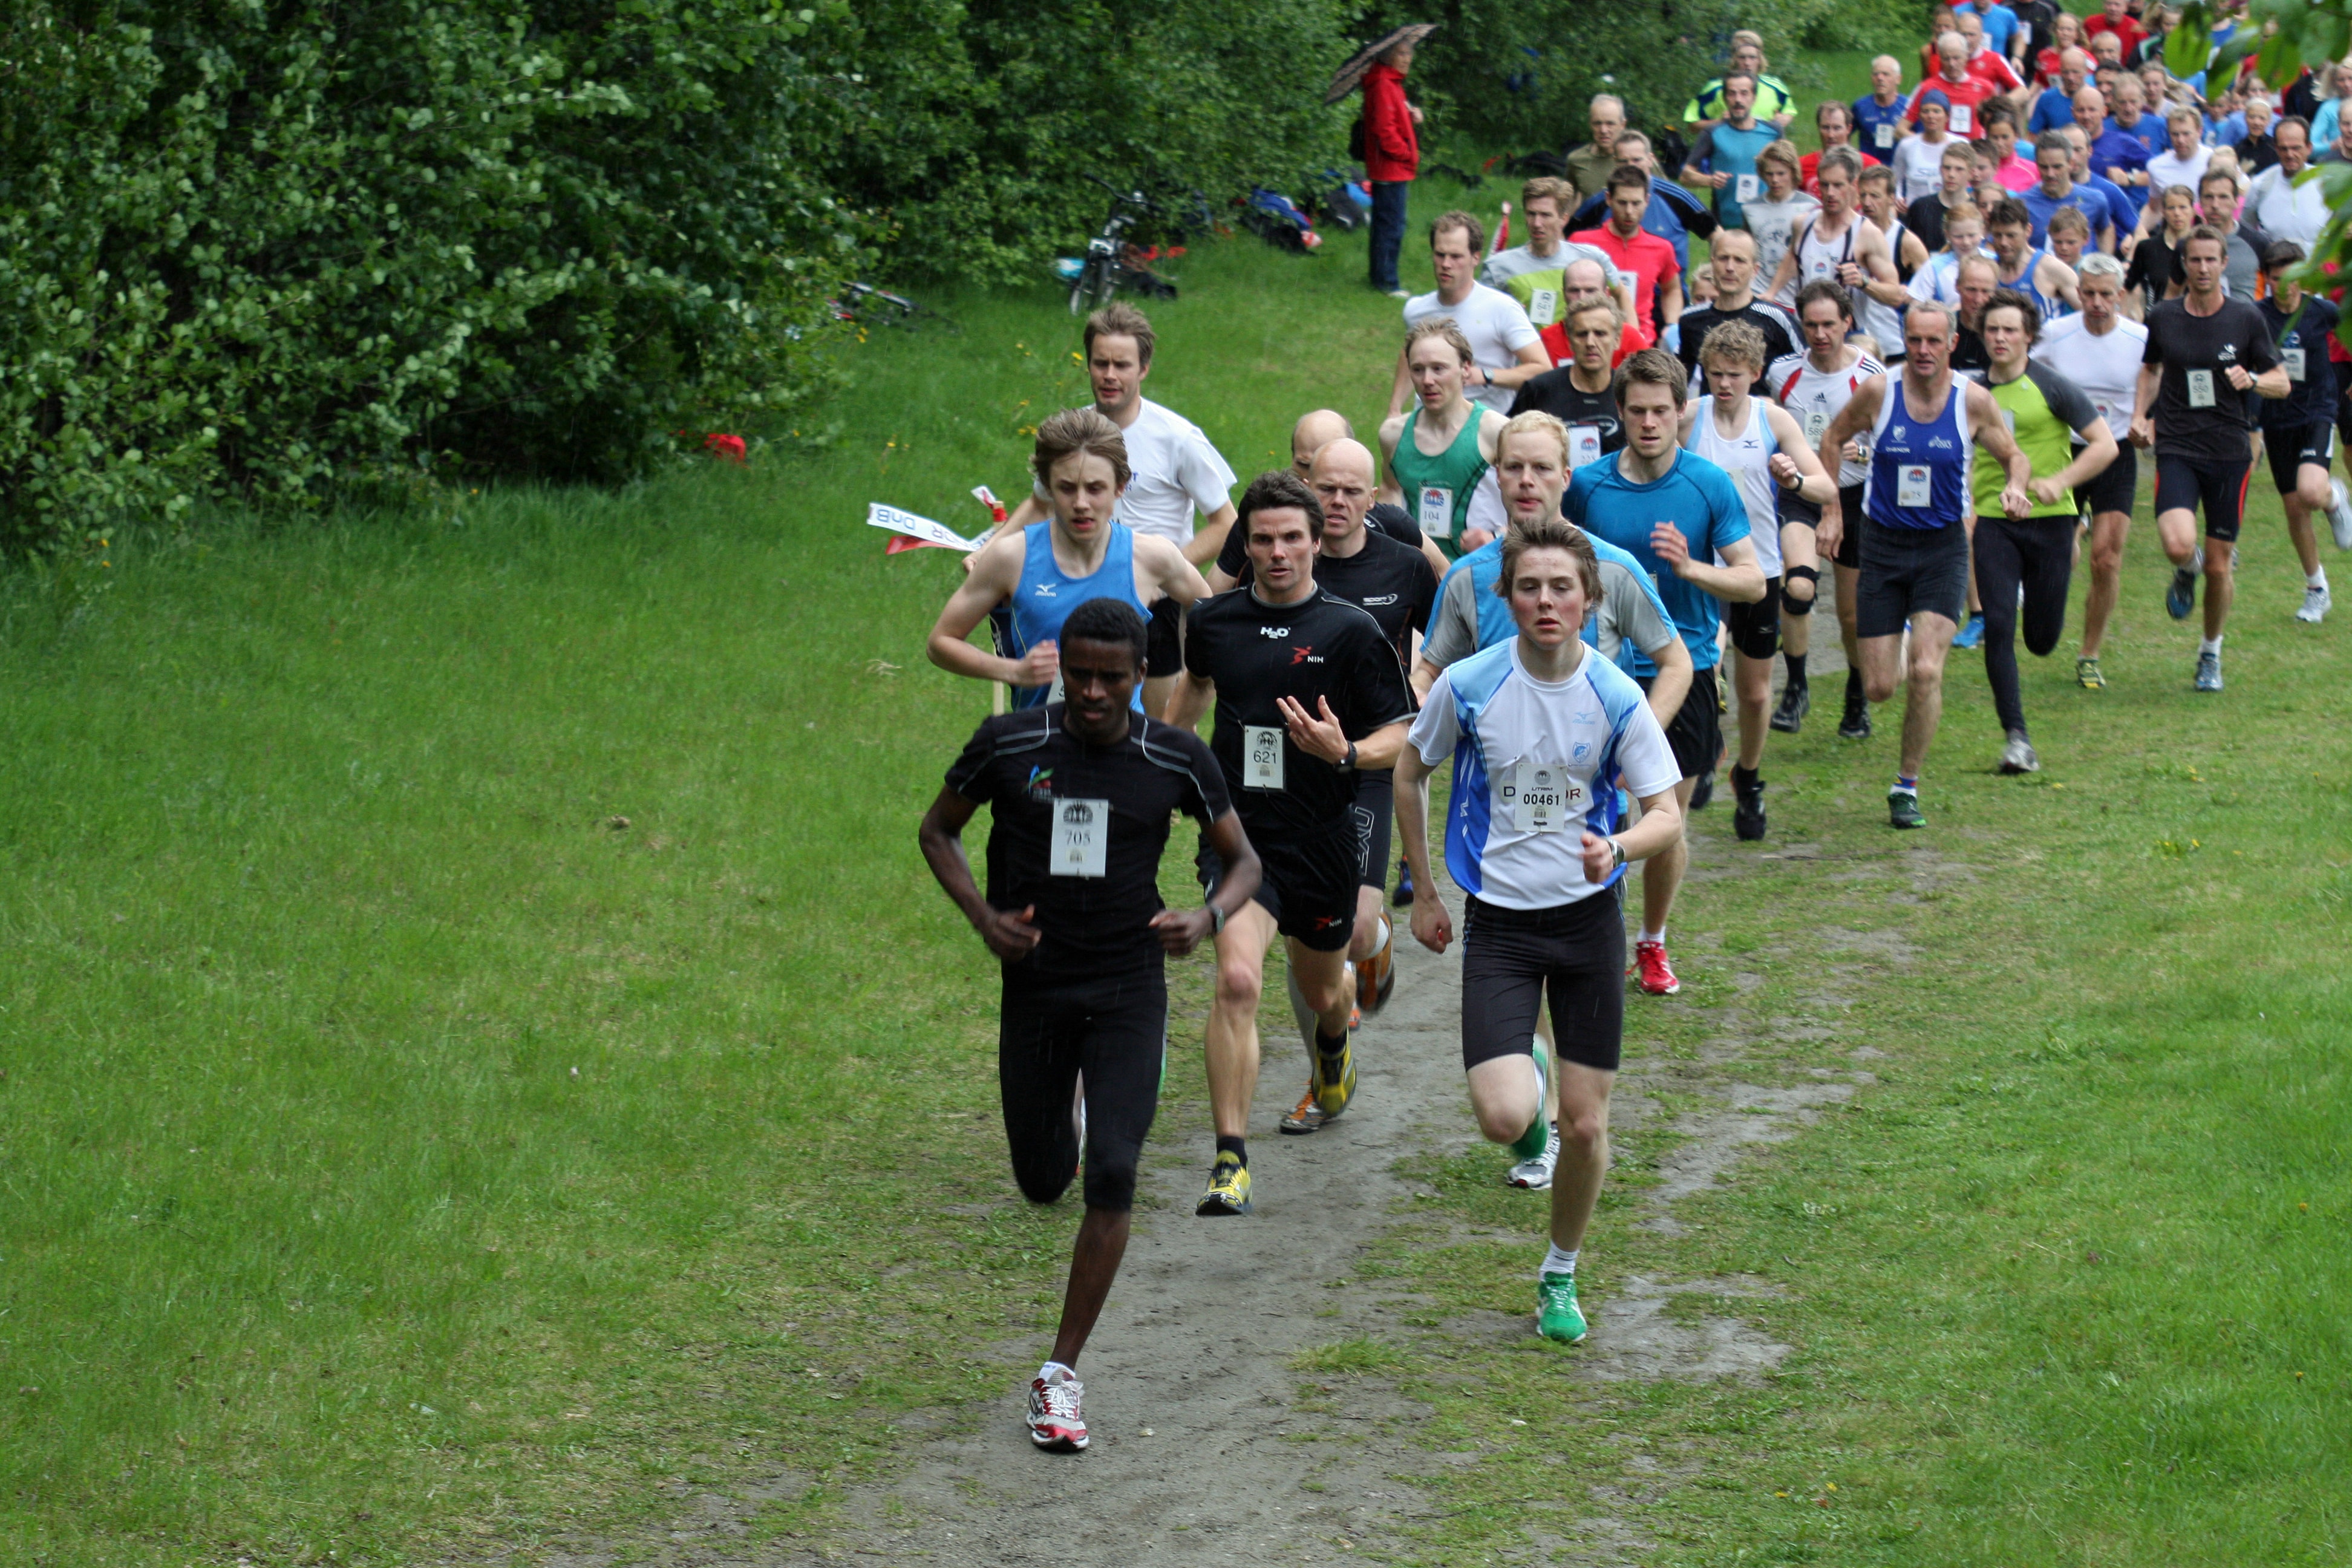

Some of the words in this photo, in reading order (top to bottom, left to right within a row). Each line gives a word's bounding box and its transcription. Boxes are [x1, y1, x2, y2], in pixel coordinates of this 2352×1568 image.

[877, 509, 916, 531] DnB
[1253, 750, 1276, 764] 621
[1523, 794, 1559, 805] 00461
